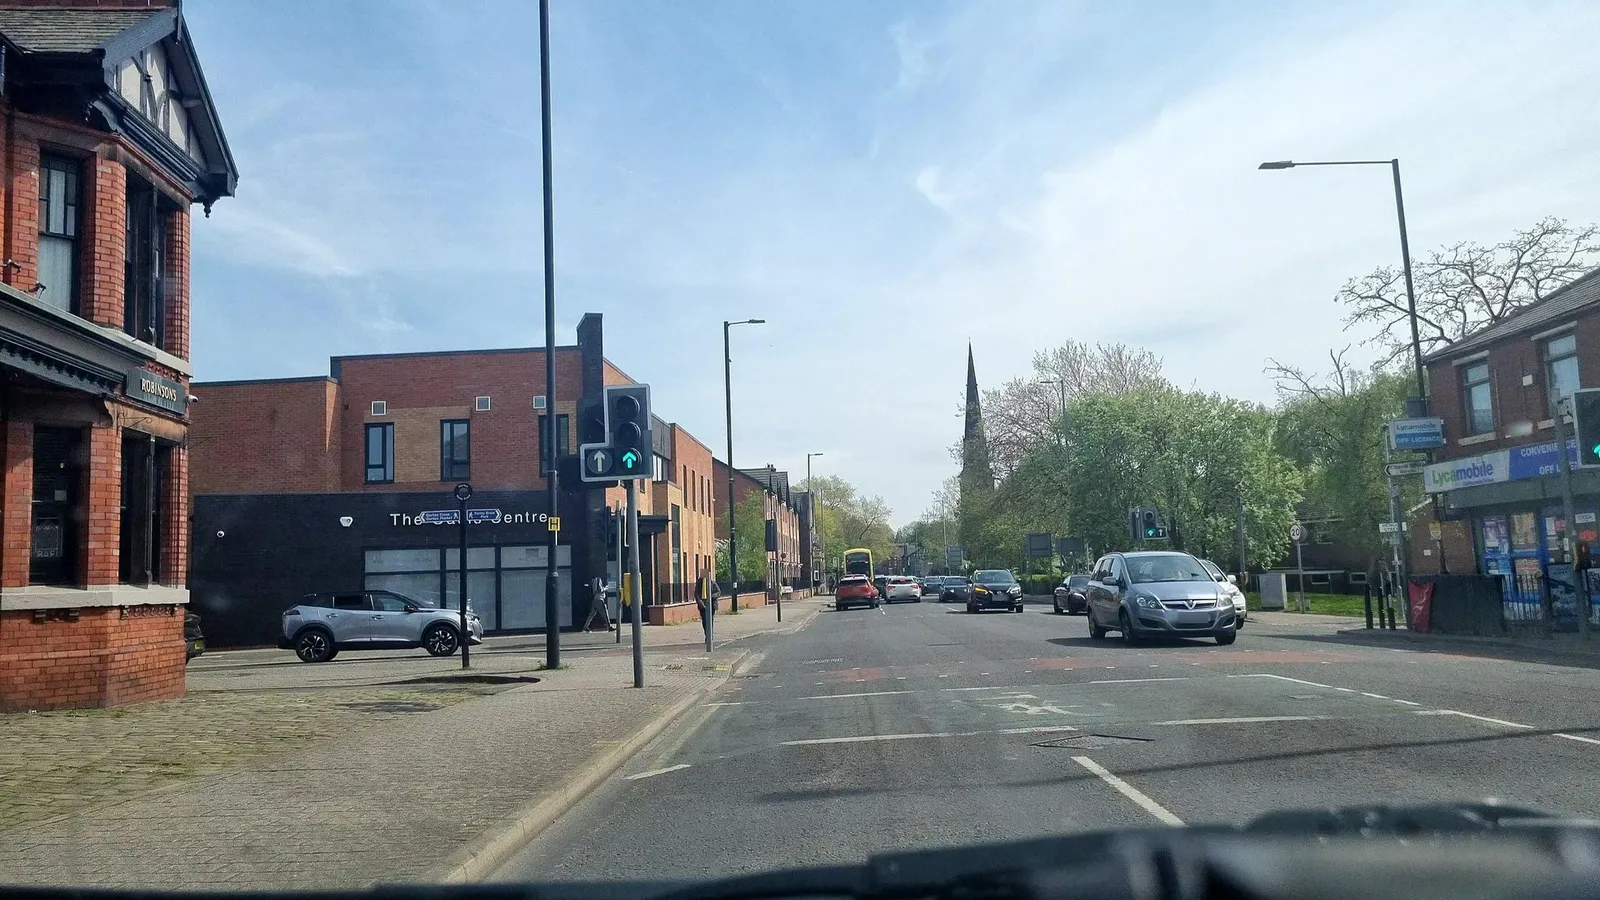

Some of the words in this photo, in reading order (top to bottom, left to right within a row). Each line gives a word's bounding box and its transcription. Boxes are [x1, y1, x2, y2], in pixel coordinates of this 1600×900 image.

[141, 378, 177, 401] ROBINSONS
[1396, 422, 1437, 431] Lycamobile
[1432, 460, 1494, 487] Lycamobile
[1539, 464, 1555, 475] OFF
[389, 513, 423, 526] The
[1291, 528, 1300, 537] 20
